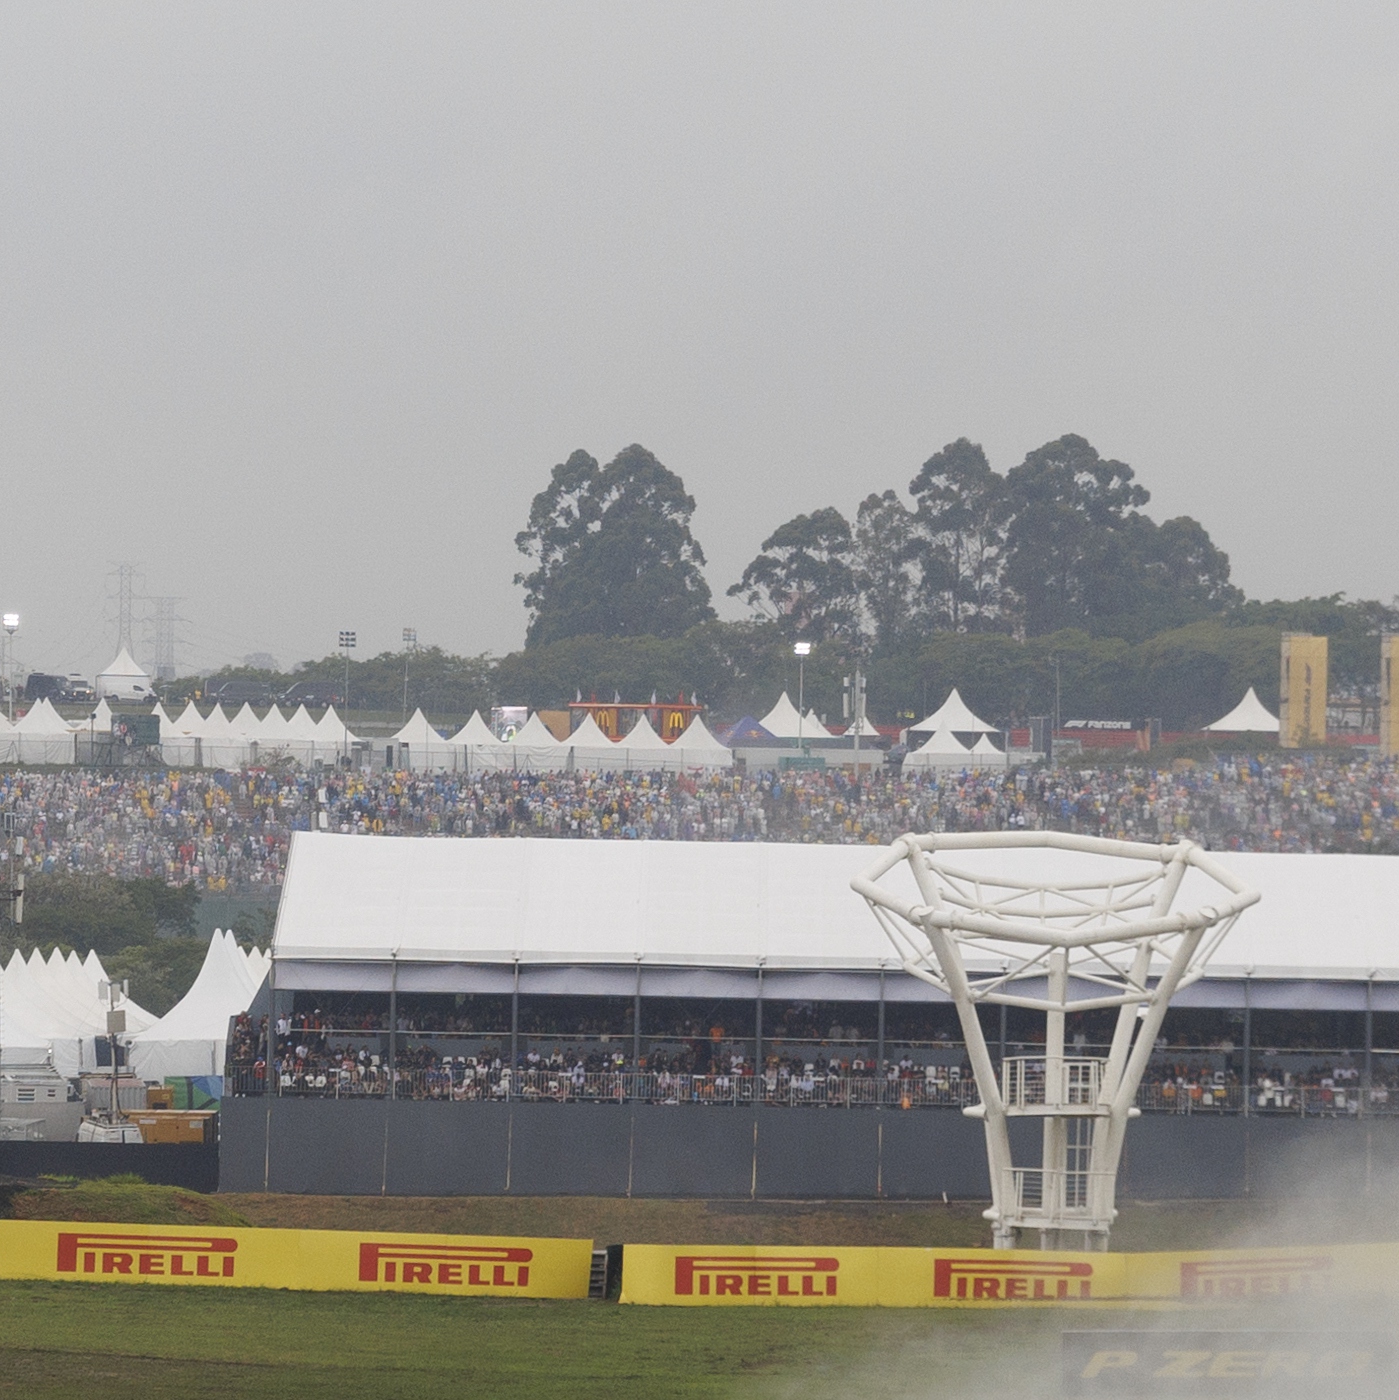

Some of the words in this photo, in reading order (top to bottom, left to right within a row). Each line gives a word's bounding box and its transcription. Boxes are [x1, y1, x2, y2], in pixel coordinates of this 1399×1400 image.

[57, 1232, 238, 1278] PIRELLI
[358, 1242, 533, 1287] PIRELLI
[1180, 1254, 1335, 1297] PIRELLI
[674, 1256, 840, 1297] PIRELLI
[933, 1258, 1094, 1300] PIRELLI
[1080, 1350, 1138, 1379] P
[1151, 1349, 1376, 1379] ZERO
